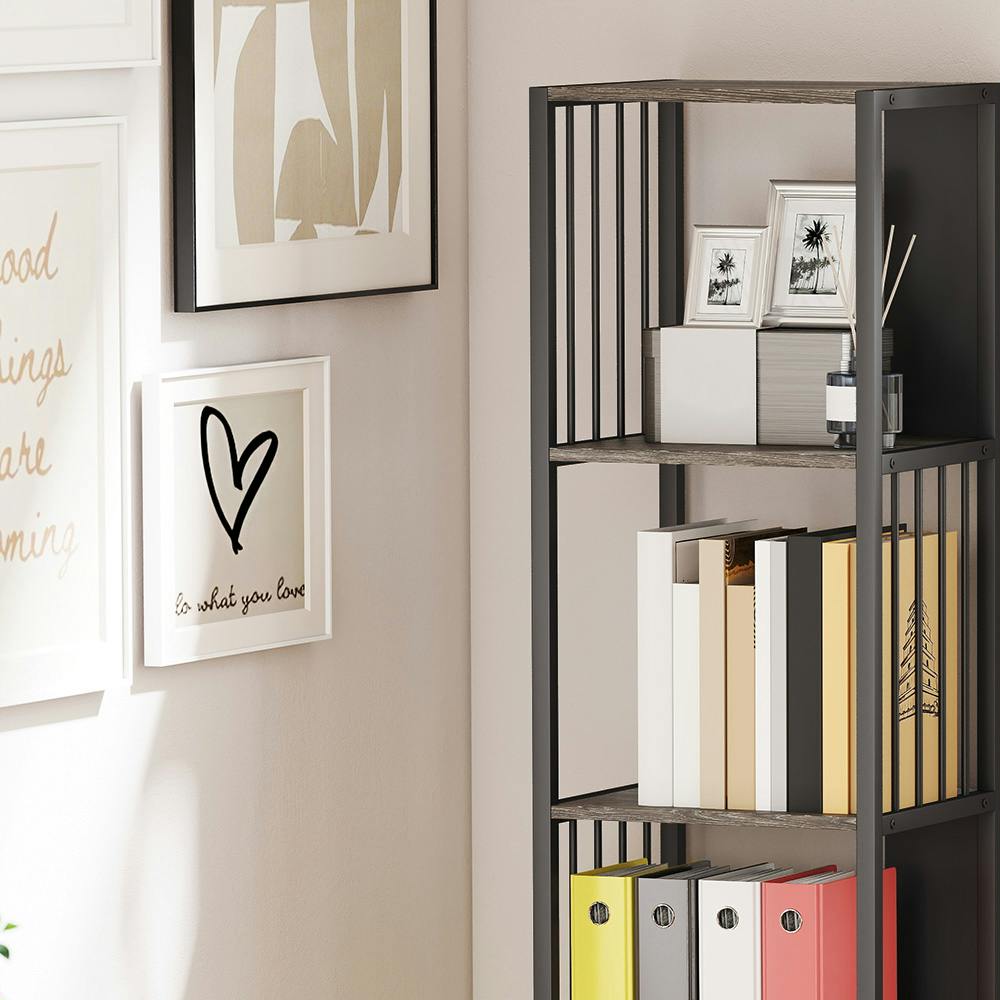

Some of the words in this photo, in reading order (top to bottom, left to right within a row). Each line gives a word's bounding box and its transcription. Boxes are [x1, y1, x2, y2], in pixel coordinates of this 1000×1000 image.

[0, 210, 59, 285] ood
[0, 319, 72, 407] ings
[0, 511, 80, 580] ming
[197, 585, 237, 612] what
[241, 590, 272, 615] you
[276, 576, 305, 602] love
